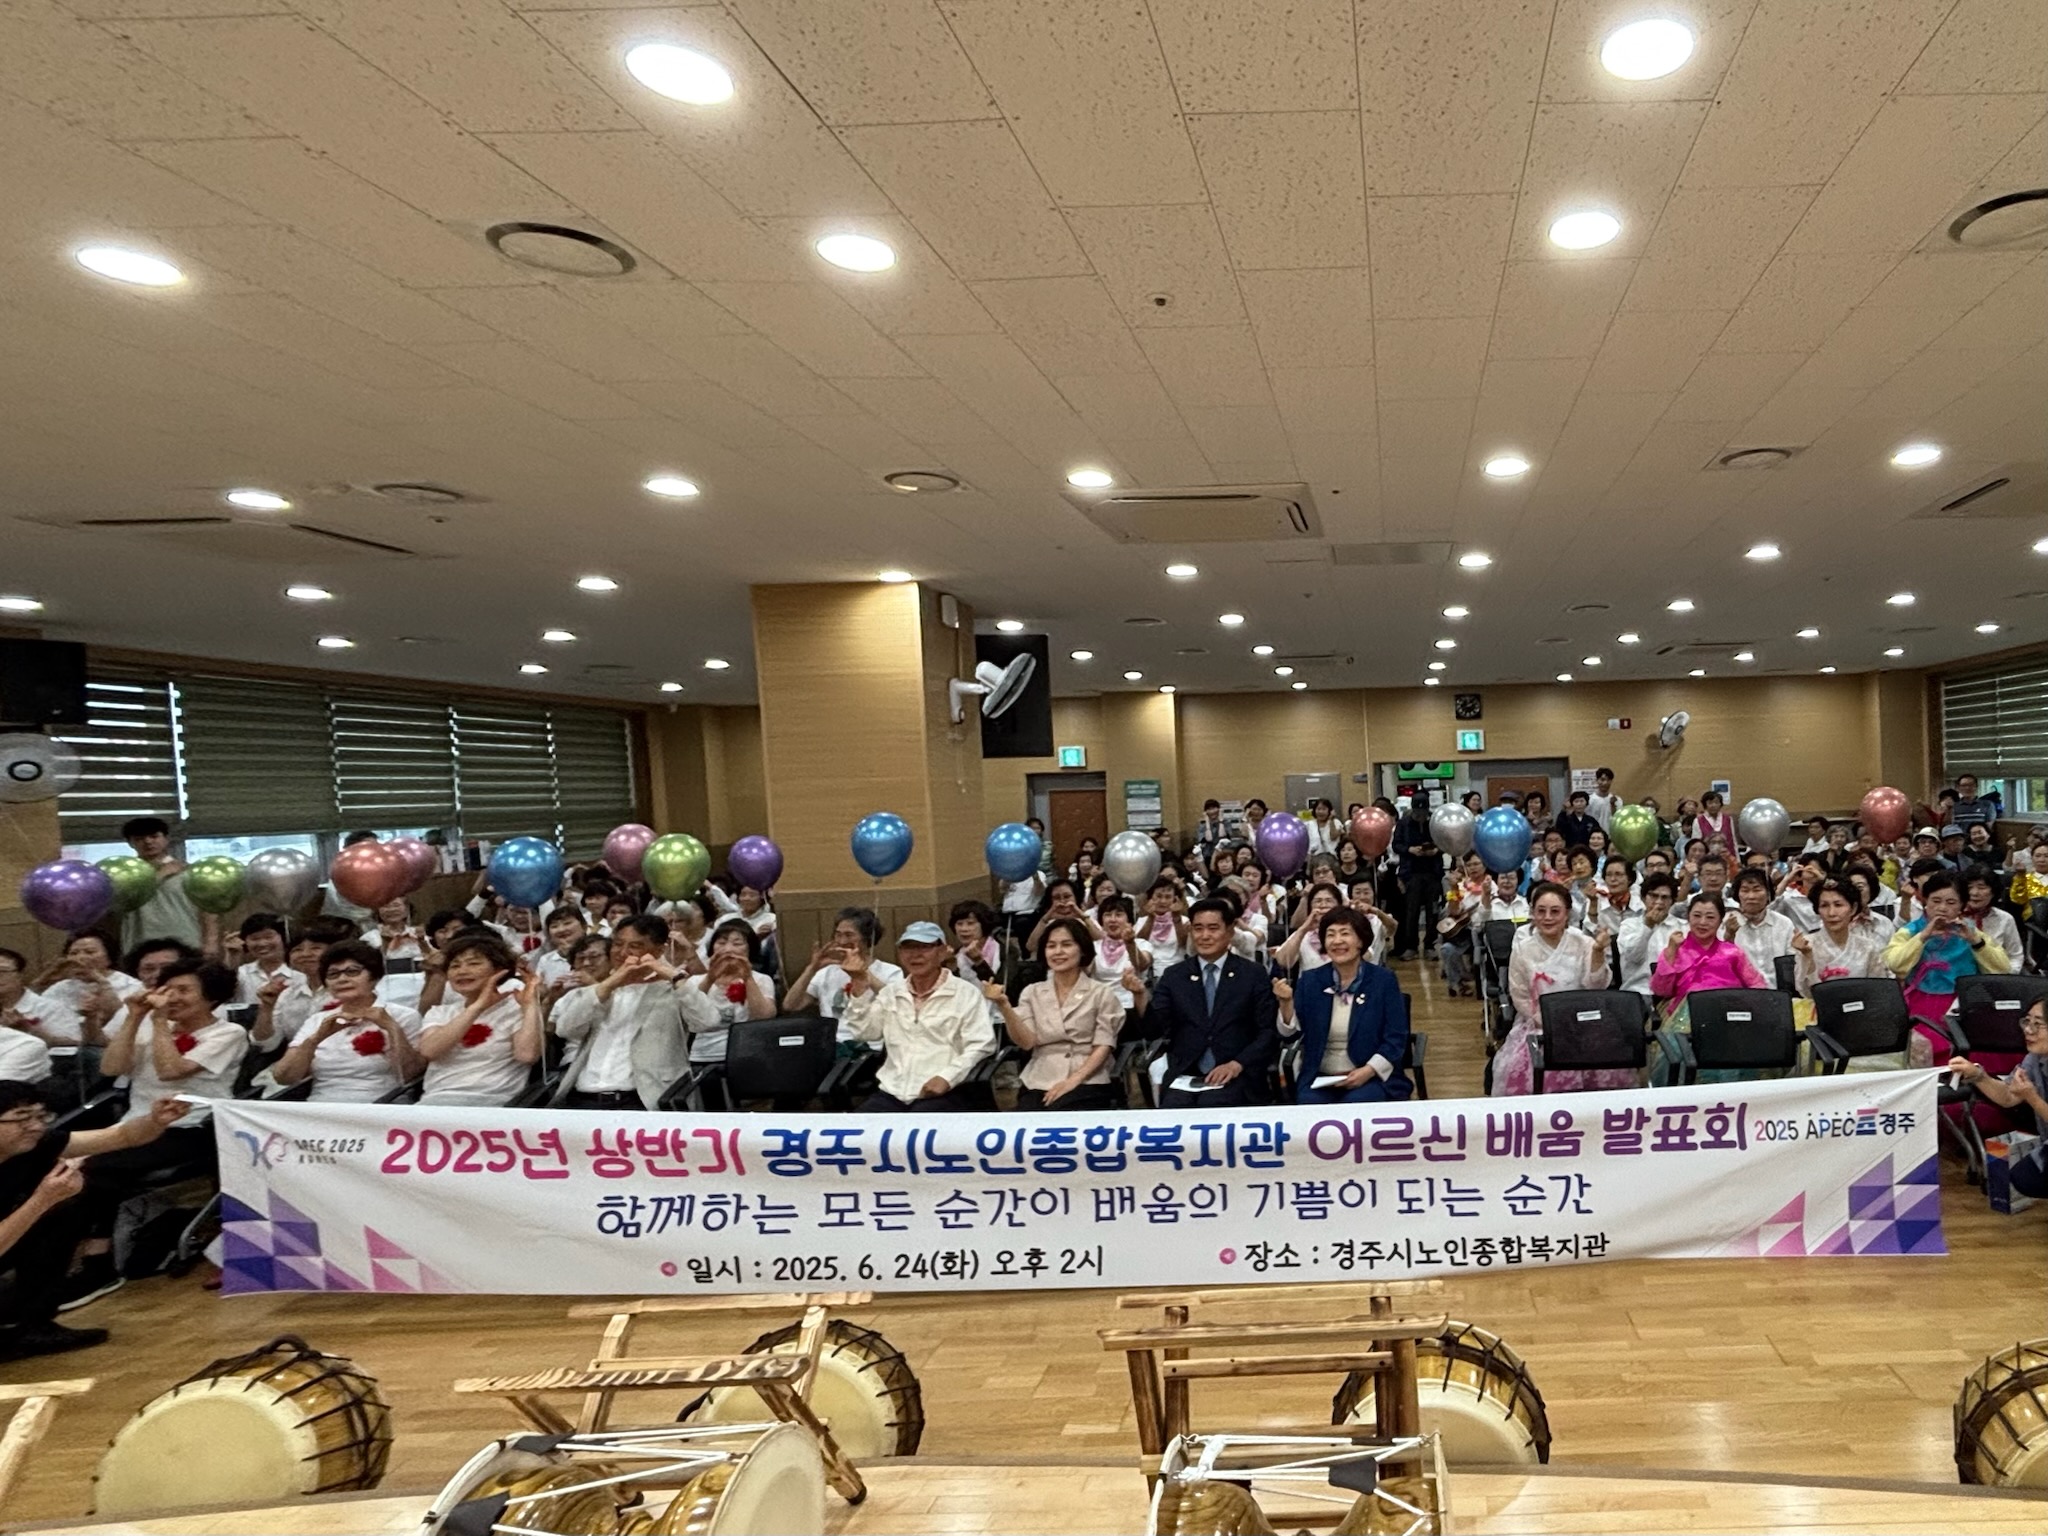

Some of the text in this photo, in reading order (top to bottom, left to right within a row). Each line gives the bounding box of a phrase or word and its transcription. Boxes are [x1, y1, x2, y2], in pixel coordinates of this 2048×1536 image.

[328, 1138, 367, 1153] 2025
[380, 1101, 1749, 1180] 2025년 상반기 경주시노인종합복지관 어르신 배움 발표회
[1754, 1119, 1800, 1142] 2025
[596, 1172, 1595, 1239] 함께하는 모든 순간이 배움의 기쁨이 되는 순간
[685, 1255, 743, 1285] 일시
[771, 1255, 848, 1283] 2025.
[858, 1253, 884, 1282] 6.
[893, 1248, 980, 1282] 24(화)
[989, 1247, 1051, 1280] 오후
[1058, 1244, 1104, 1277] 2시
[1243, 1240, 1303, 1273] 장소
[1329, 1232, 1611, 1271] 경주시노인종합복지관
